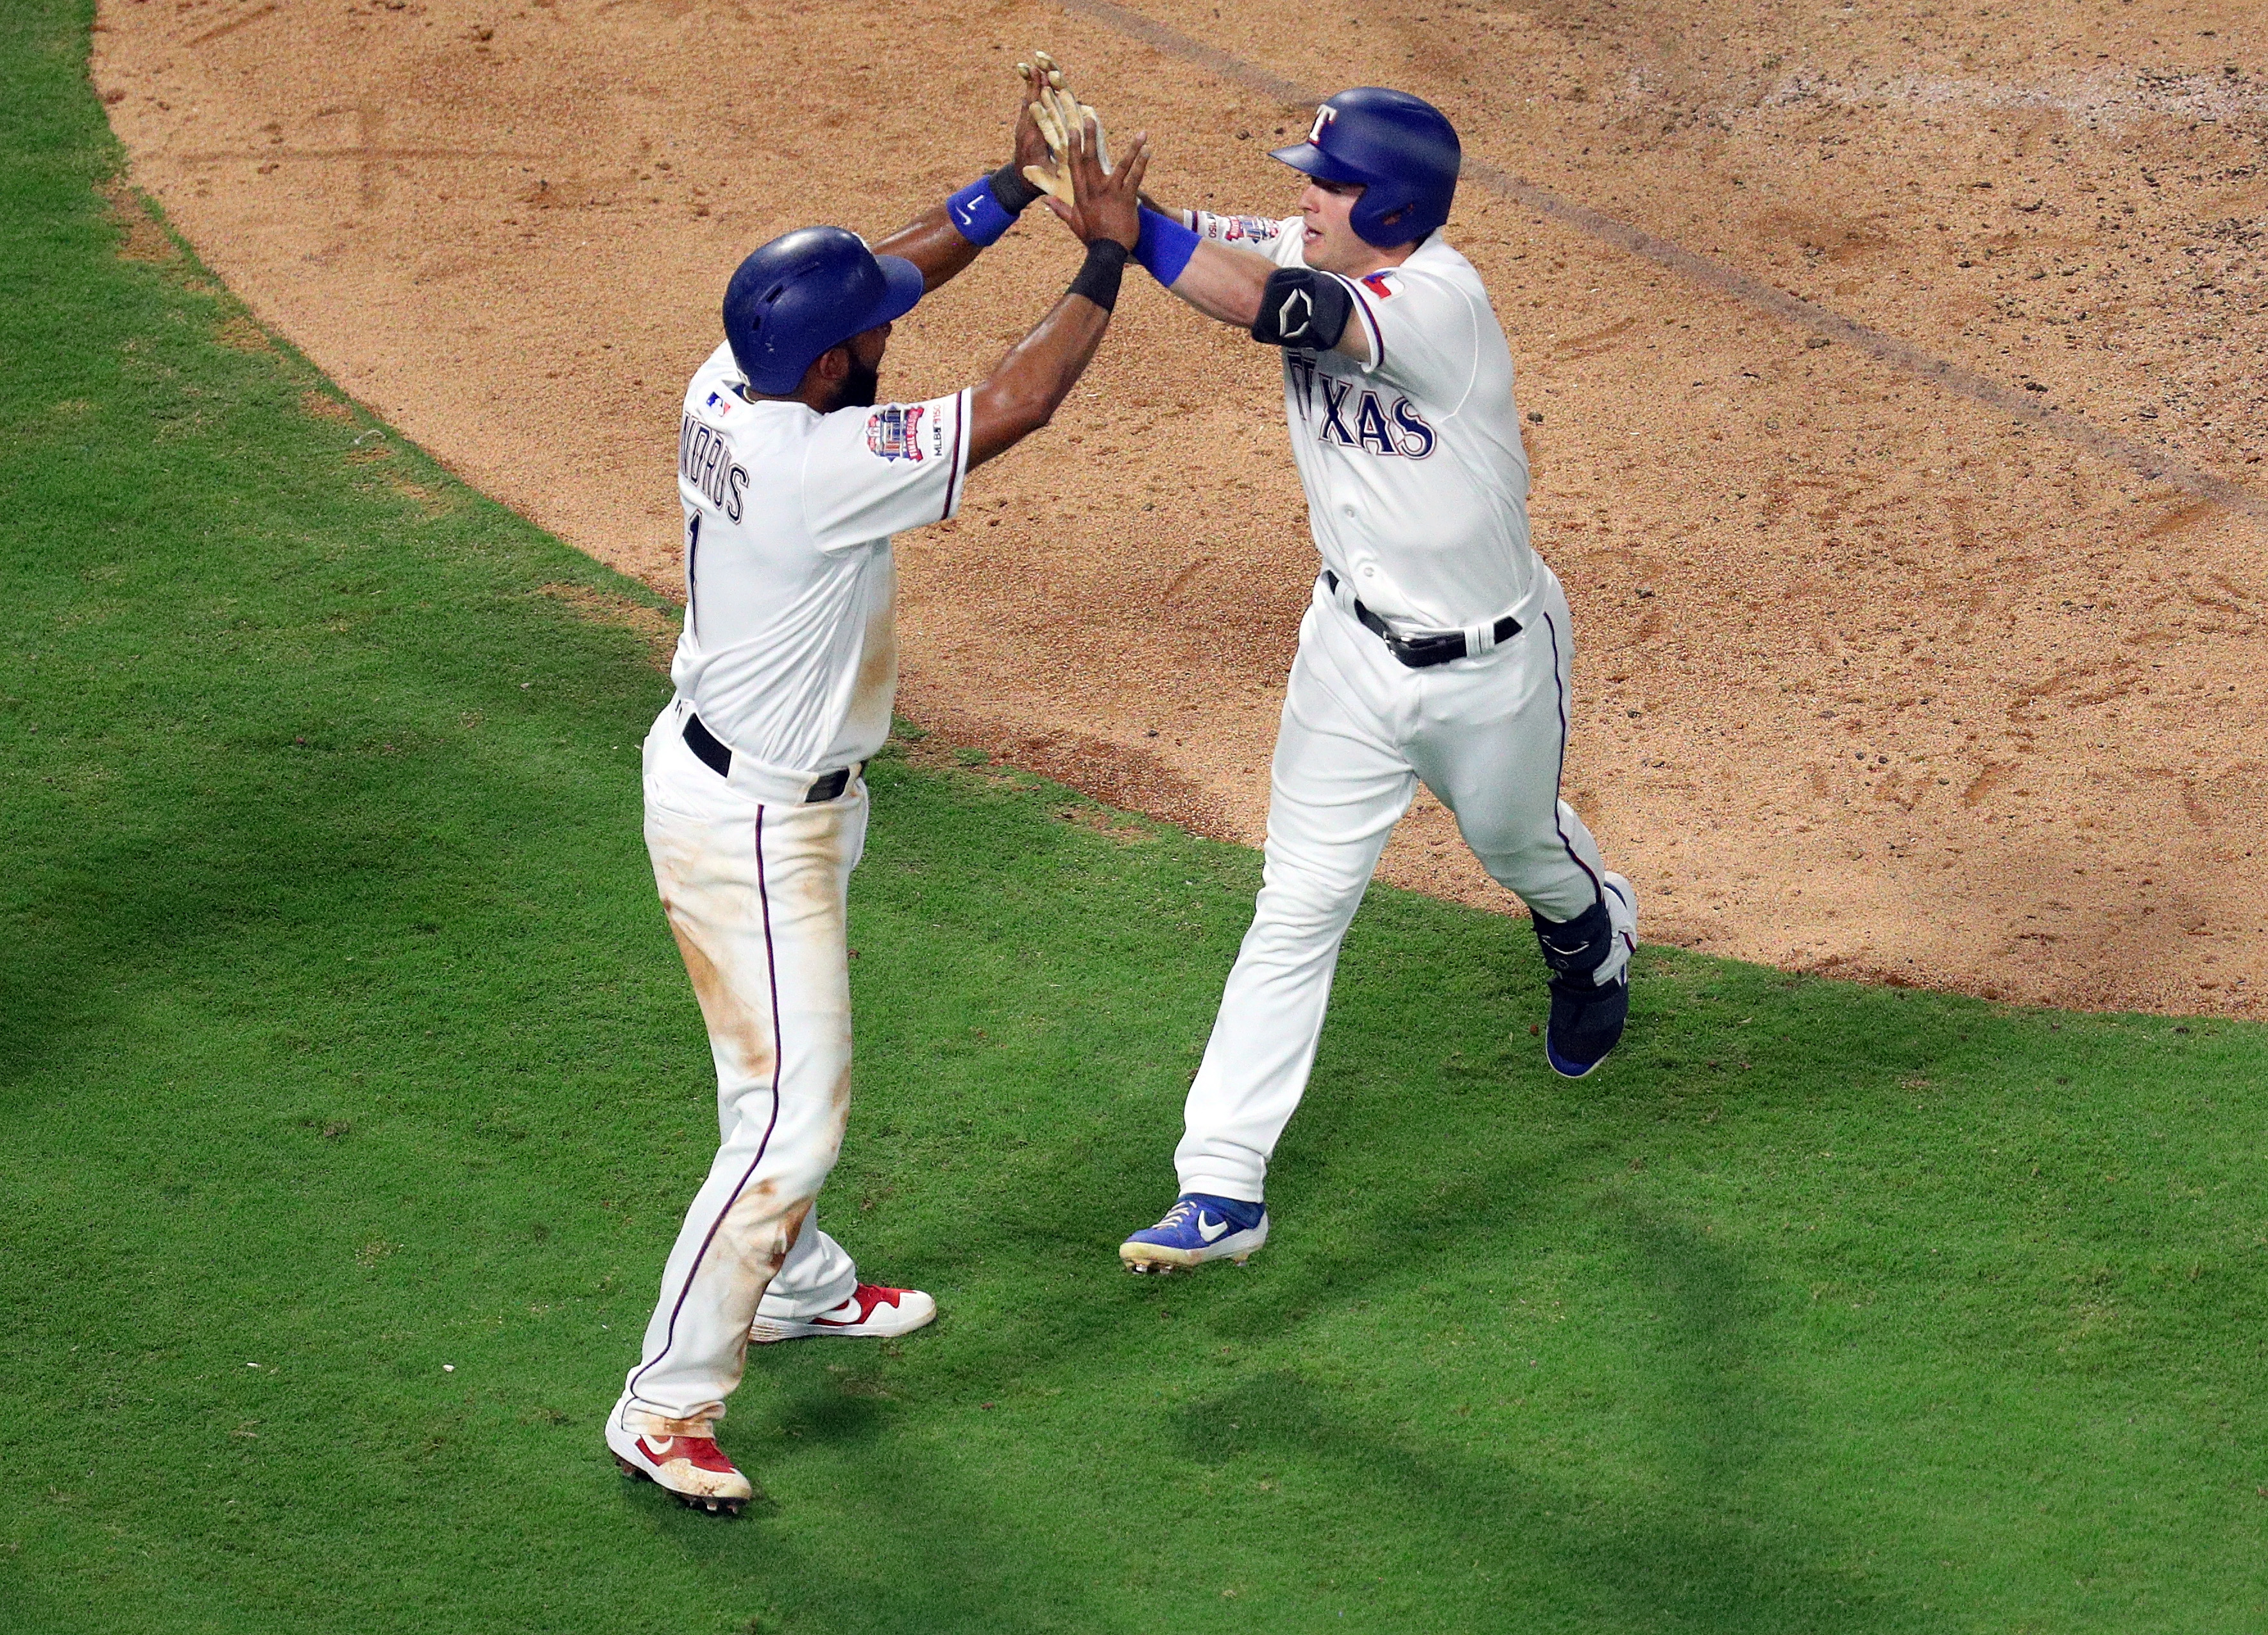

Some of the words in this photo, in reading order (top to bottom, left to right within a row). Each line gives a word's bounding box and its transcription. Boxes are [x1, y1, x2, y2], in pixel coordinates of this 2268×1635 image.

[1308, 103, 1338, 145] T
[907, 409, 919, 435] SEASON
[907, 435, 918, 458] FINAL
[934, 434, 942, 456] MLB
